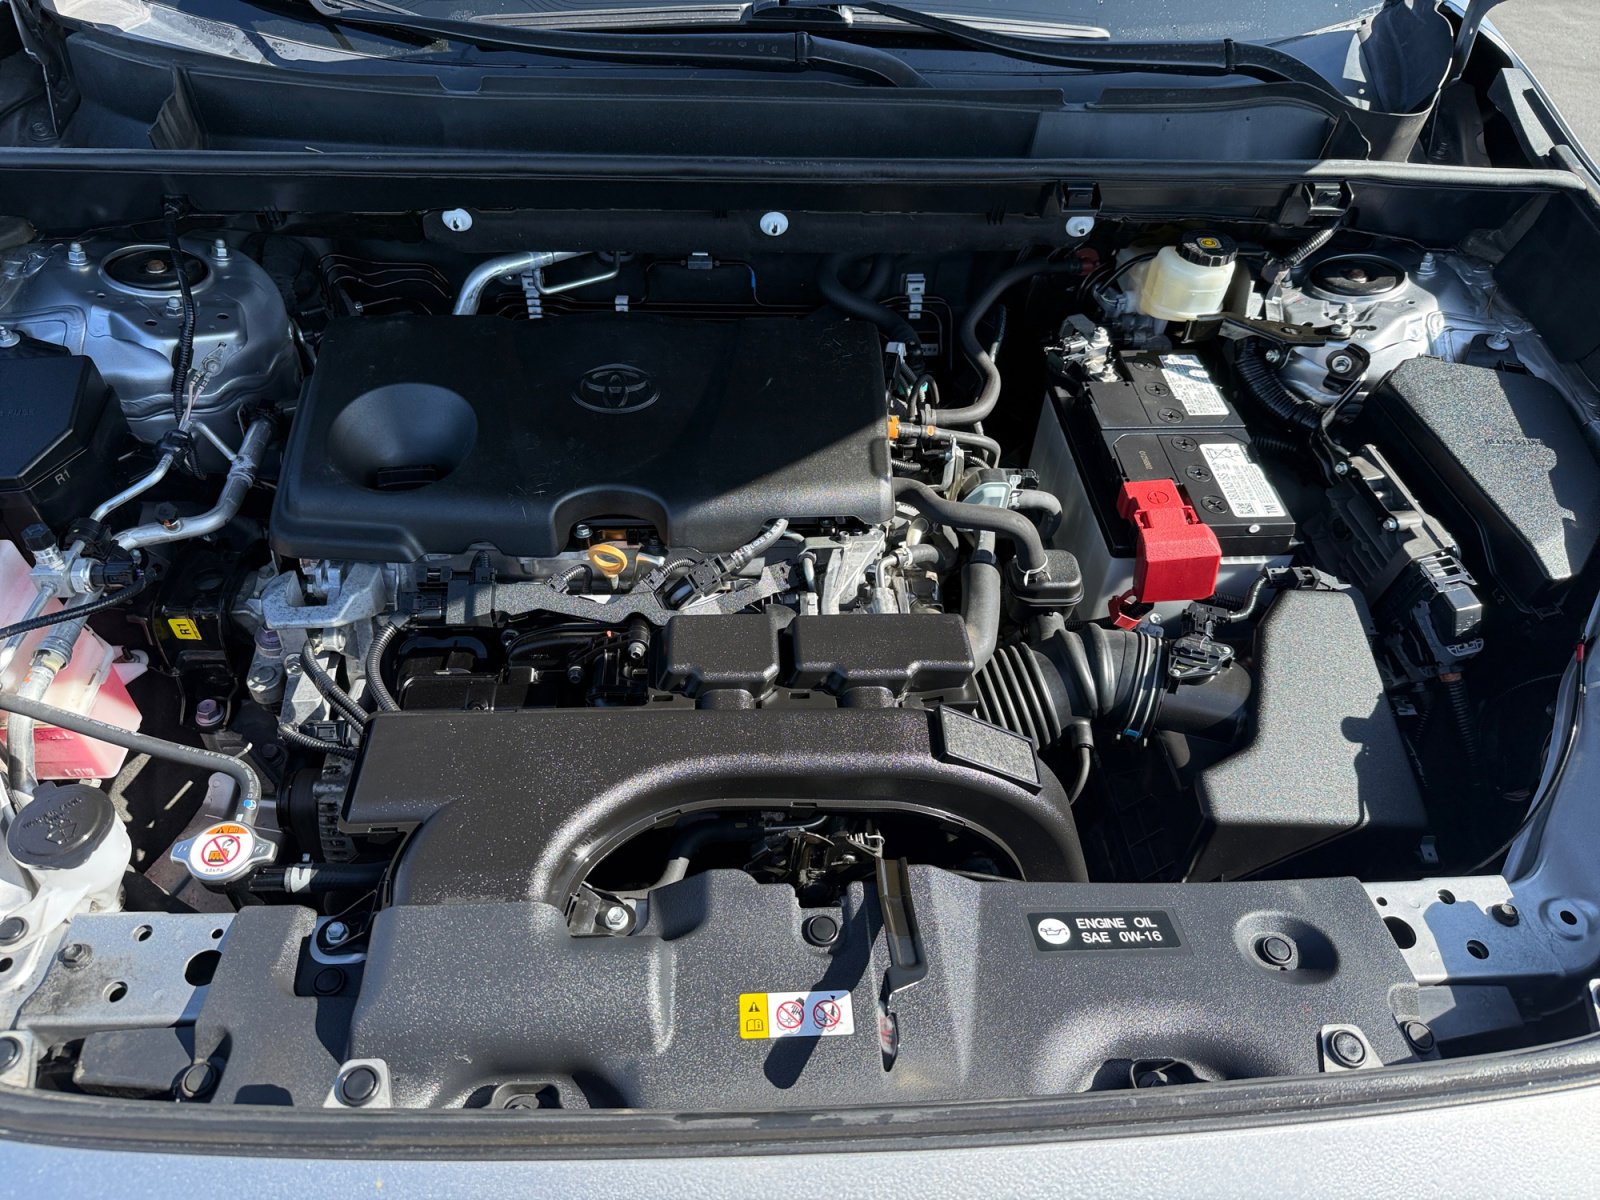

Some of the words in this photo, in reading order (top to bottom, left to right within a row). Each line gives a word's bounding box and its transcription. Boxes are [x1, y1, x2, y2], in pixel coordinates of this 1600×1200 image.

[54, 469, 71, 485] R1
[177, 623, 191, 635] R1
[1075, 918, 1127, 929] ENGINE
[1133, 917, 1158, 928] OIL
[1081, 931, 1112, 944] SAE
[1119, 930, 1163, 942] 0W-16
